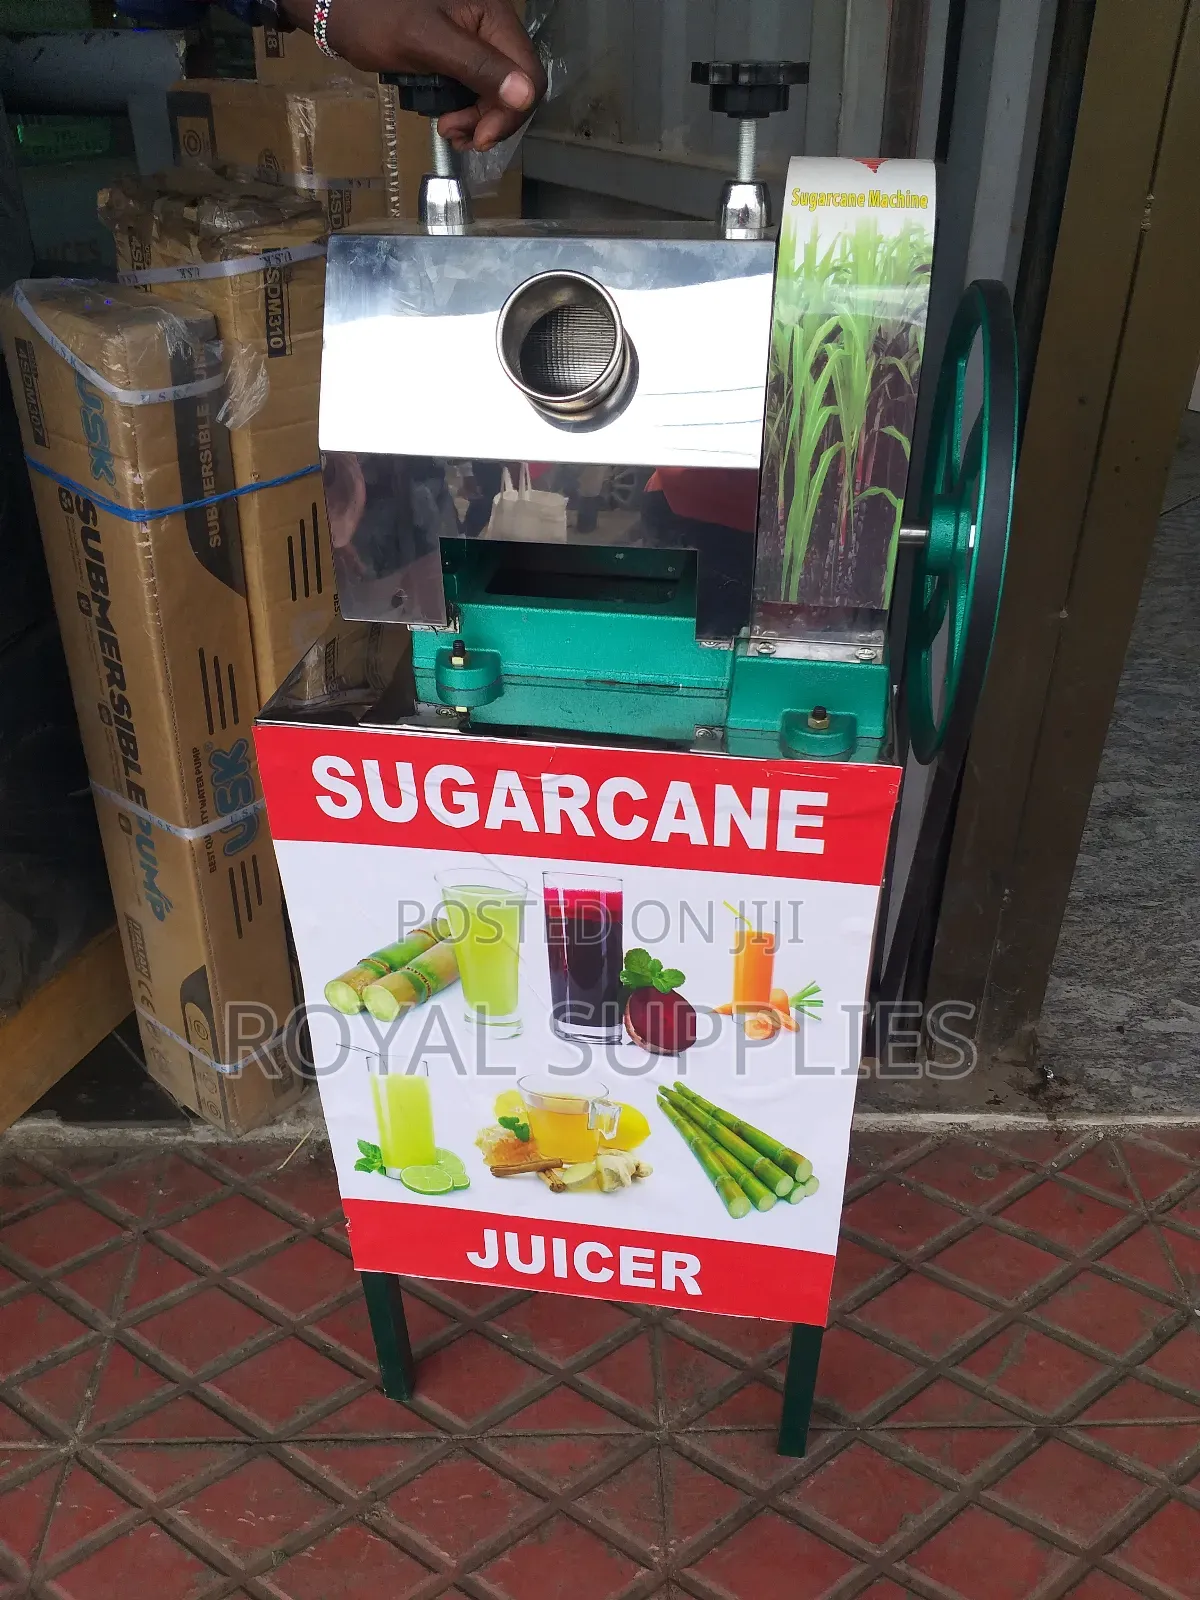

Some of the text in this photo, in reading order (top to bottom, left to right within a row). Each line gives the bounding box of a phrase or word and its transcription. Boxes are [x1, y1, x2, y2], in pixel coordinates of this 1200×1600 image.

[791, 187, 929, 212] Sugarcane Machine
[265, 267, 285, 349] SDM310
[75, 495, 149, 811] SUBMERSIBLE
[192, 746, 217, 873] BEST QUITY WATER PUMP
[208, 738, 260, 856] USK
[311, 754, 830, 856] SUGARCANE
[466, 1229, 703, 1297] JUICER
